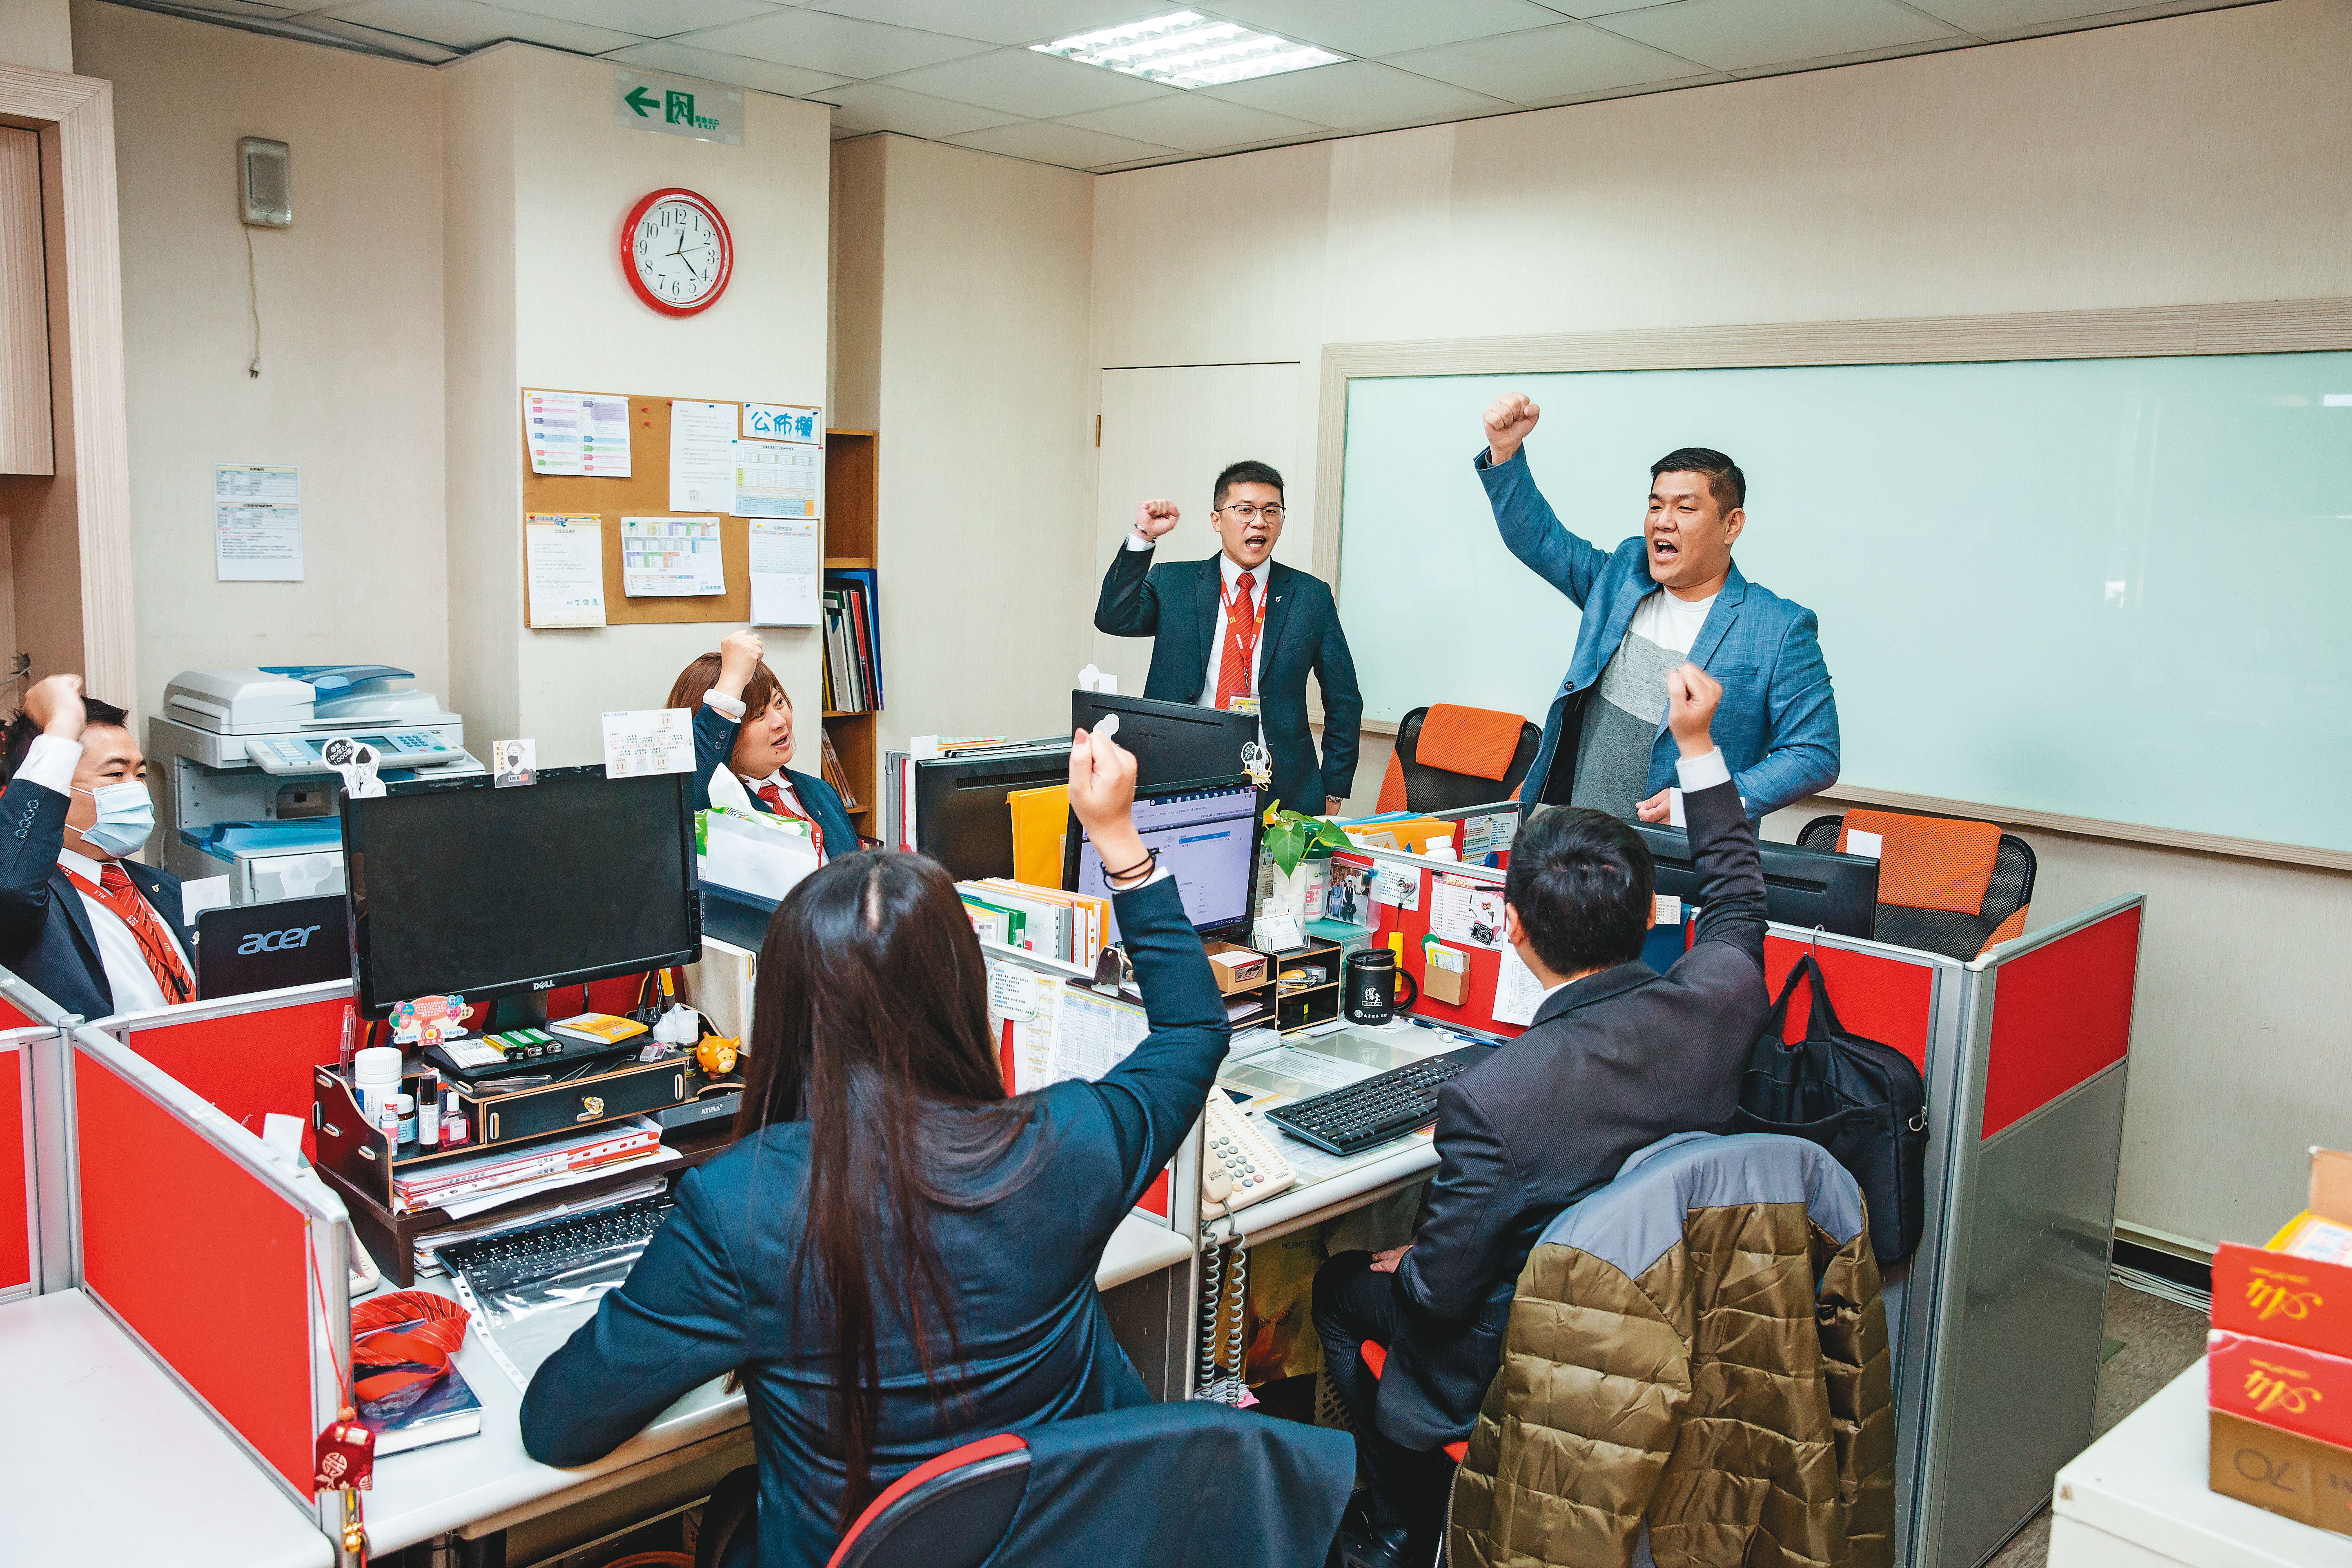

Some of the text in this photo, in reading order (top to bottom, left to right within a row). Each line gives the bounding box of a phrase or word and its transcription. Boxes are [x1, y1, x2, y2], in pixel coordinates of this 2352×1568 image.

[661, 211, 670, 227] 11
[675, 208, 686, 225] 12
[694, 216, 698, 232] 1
[646, 222, 659, 238] 10
[703, 229, 711, 245] 2
[640, 240, 648, 255] 9
[707, 249, 715, 265] 3
[645, 259, 653, 275] 8
[700, 267, 709, 281] 4
[658, 274, 666, 290] 7
[672, 281, 679, 296] 6
[688, 278, 696, 293] 5
[1446, 877, 1467, 888] 2020
[94, 890, 106, 900] ETR
[237, 925, 321, 955] acer
[533, 980, 555, 990] DELL
